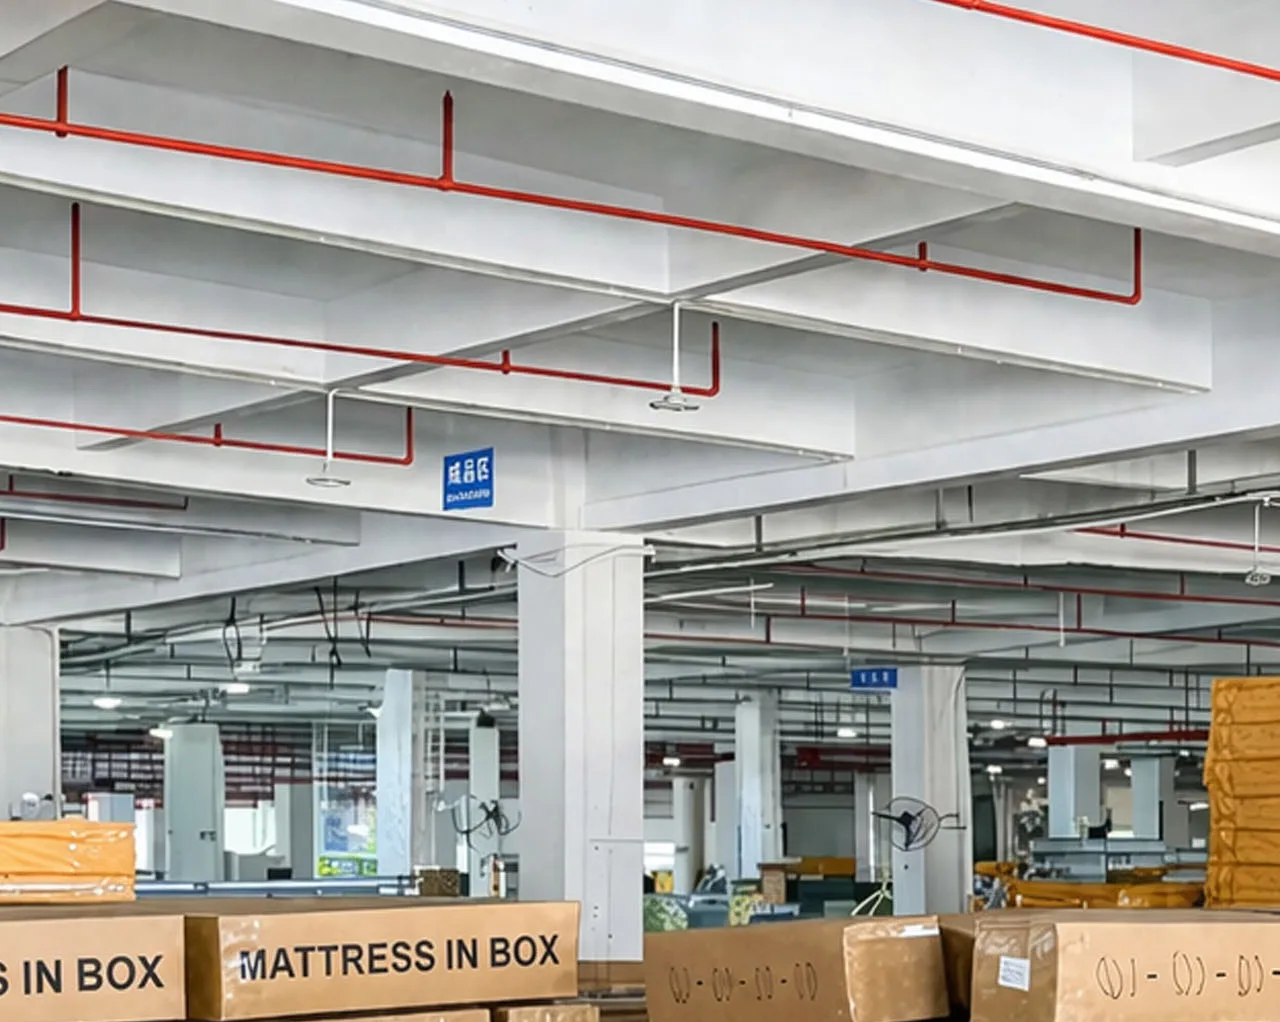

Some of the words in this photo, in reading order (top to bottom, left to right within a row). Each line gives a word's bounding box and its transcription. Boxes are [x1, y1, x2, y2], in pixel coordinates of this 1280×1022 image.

[23, 959, 62, 995] IN
[77, 955, 165, 992] BOX
[239, 940, 435, 980] MATTRESS
[446, 938, 478, 970] IN
[489, 934, 560, 967] BOX
